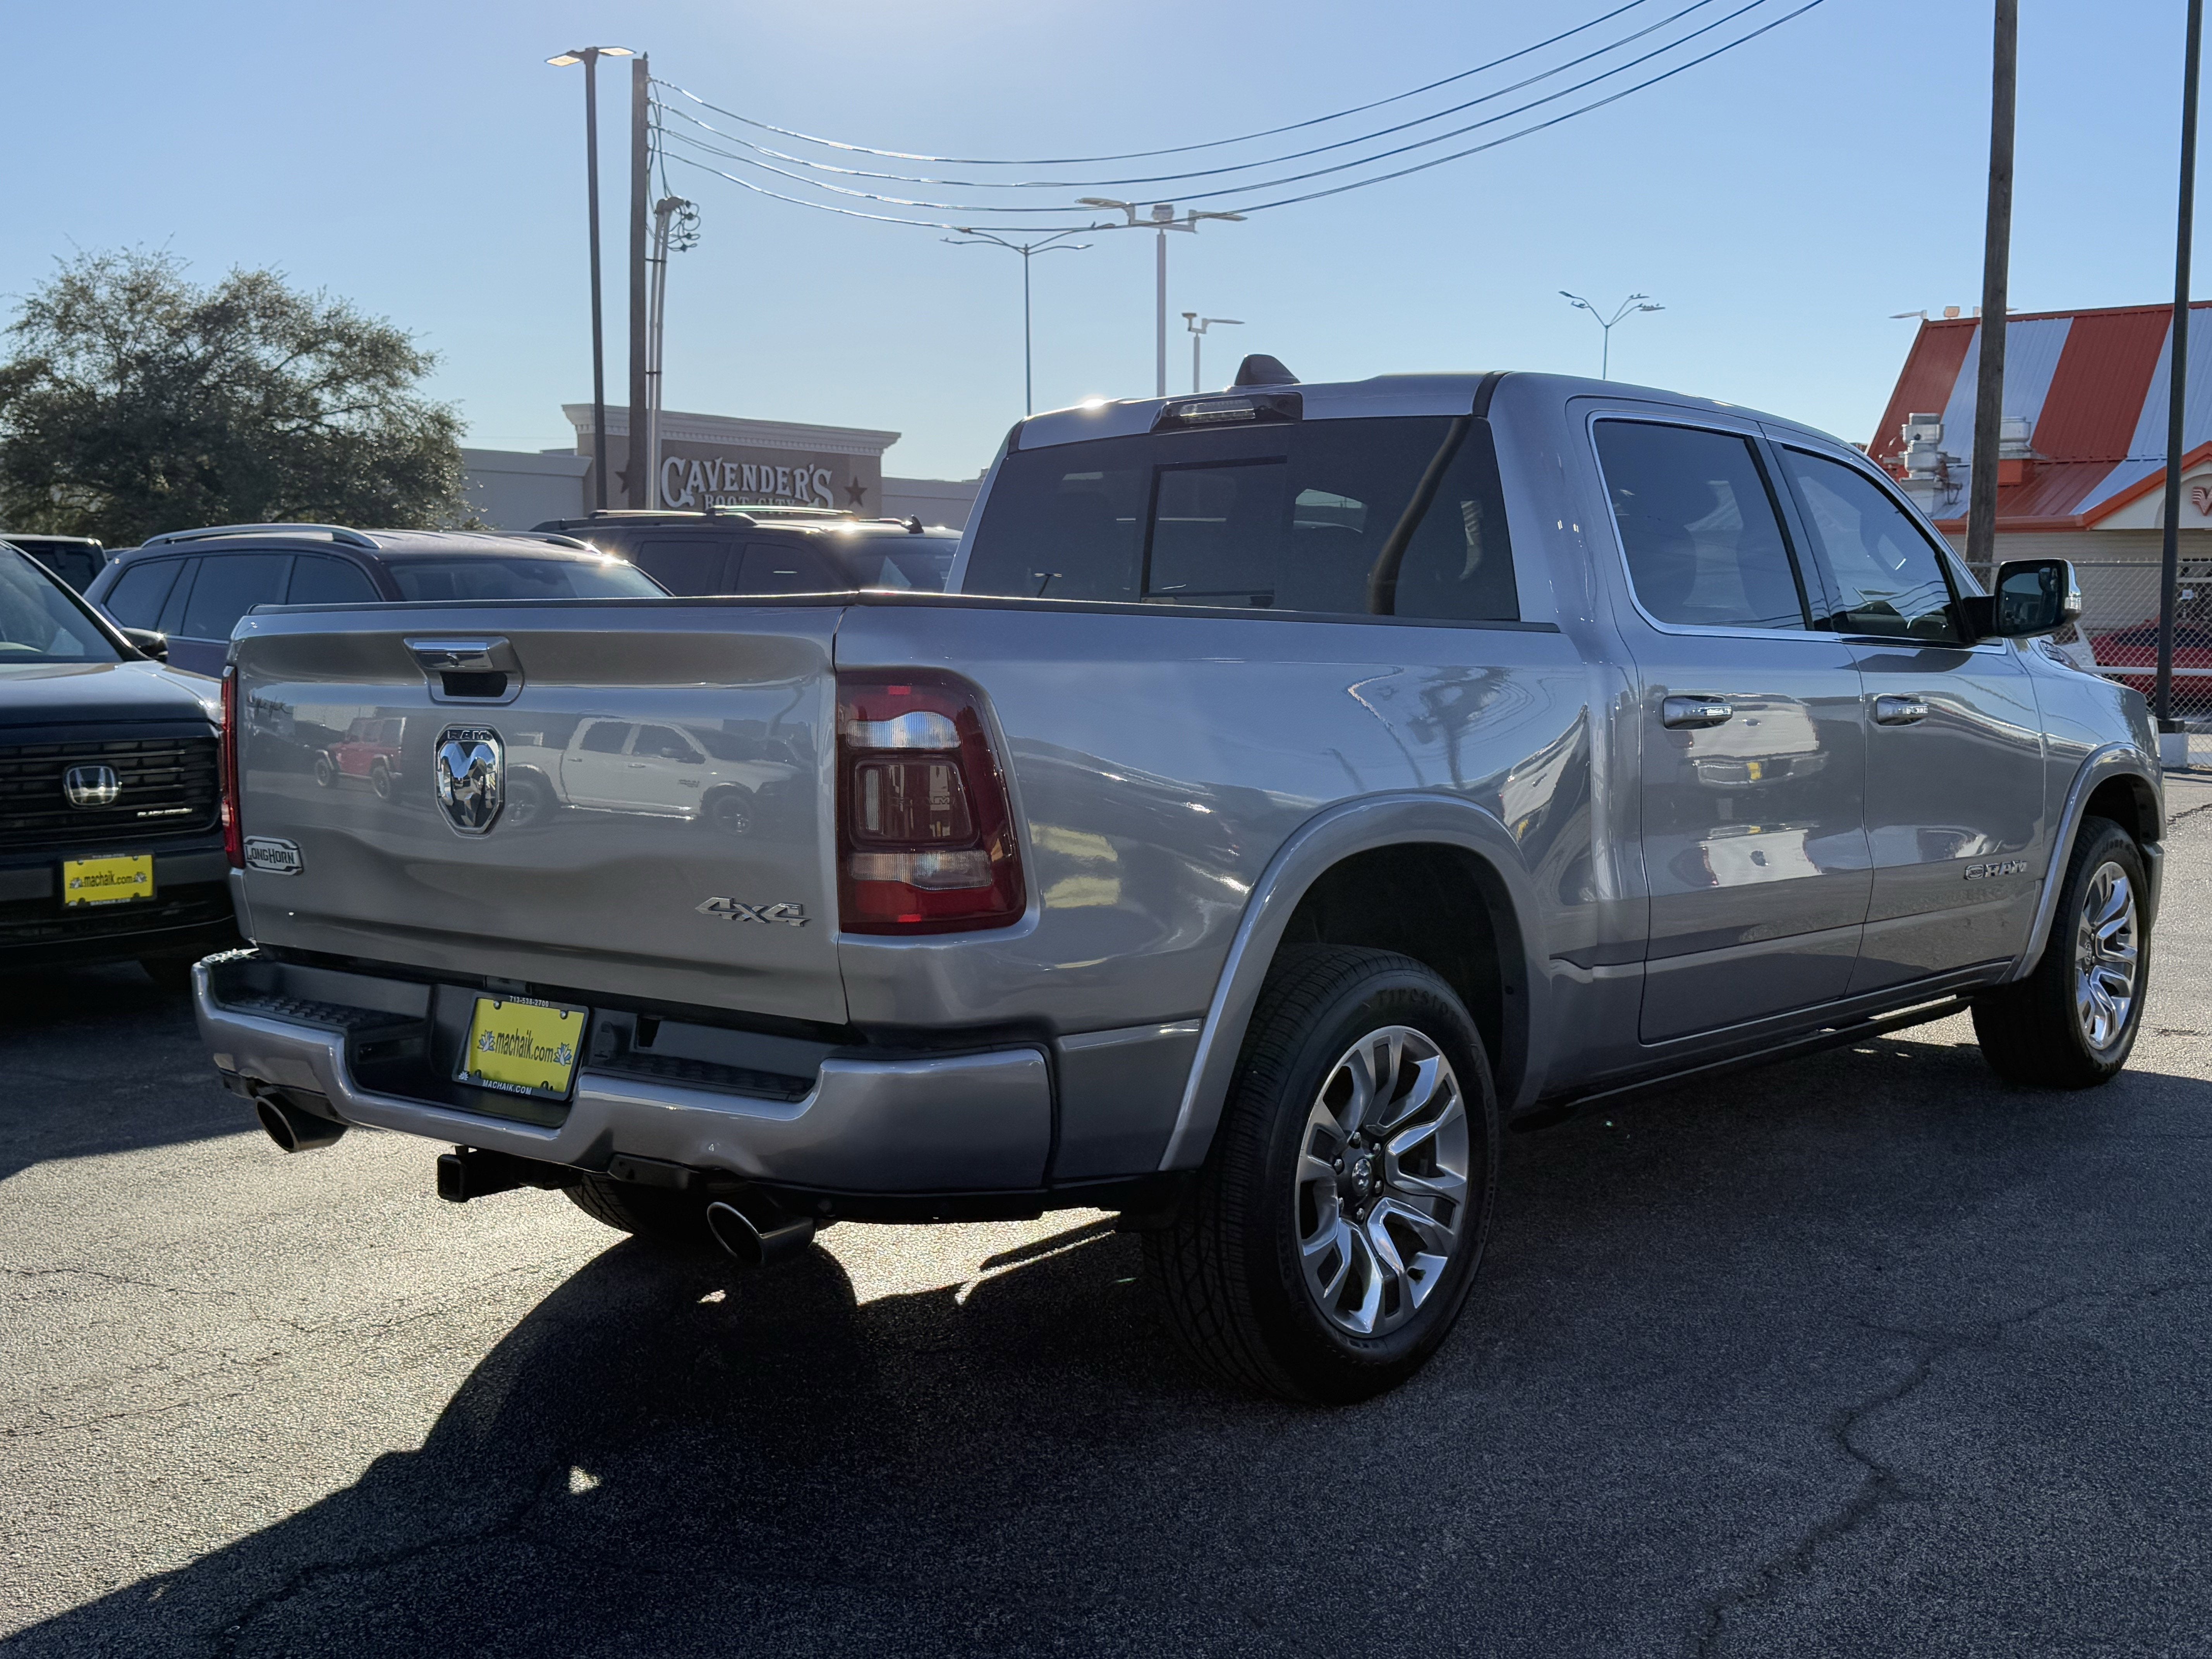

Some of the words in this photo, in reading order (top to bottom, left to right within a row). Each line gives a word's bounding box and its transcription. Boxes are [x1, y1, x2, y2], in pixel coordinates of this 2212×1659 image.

[661, 456, 834, 508] CAVENDER'S
[447, 730, 492, 740] RAM
[245, 845, 295, 864] LONGHORN
[1983, 860, 2027, 878] RAM
[84, 871, 132, 887] machaik.com
[495, 1028, 554, 1063] machaik.com
[482, 1079, 532, 1095] MACHAIK.COM
